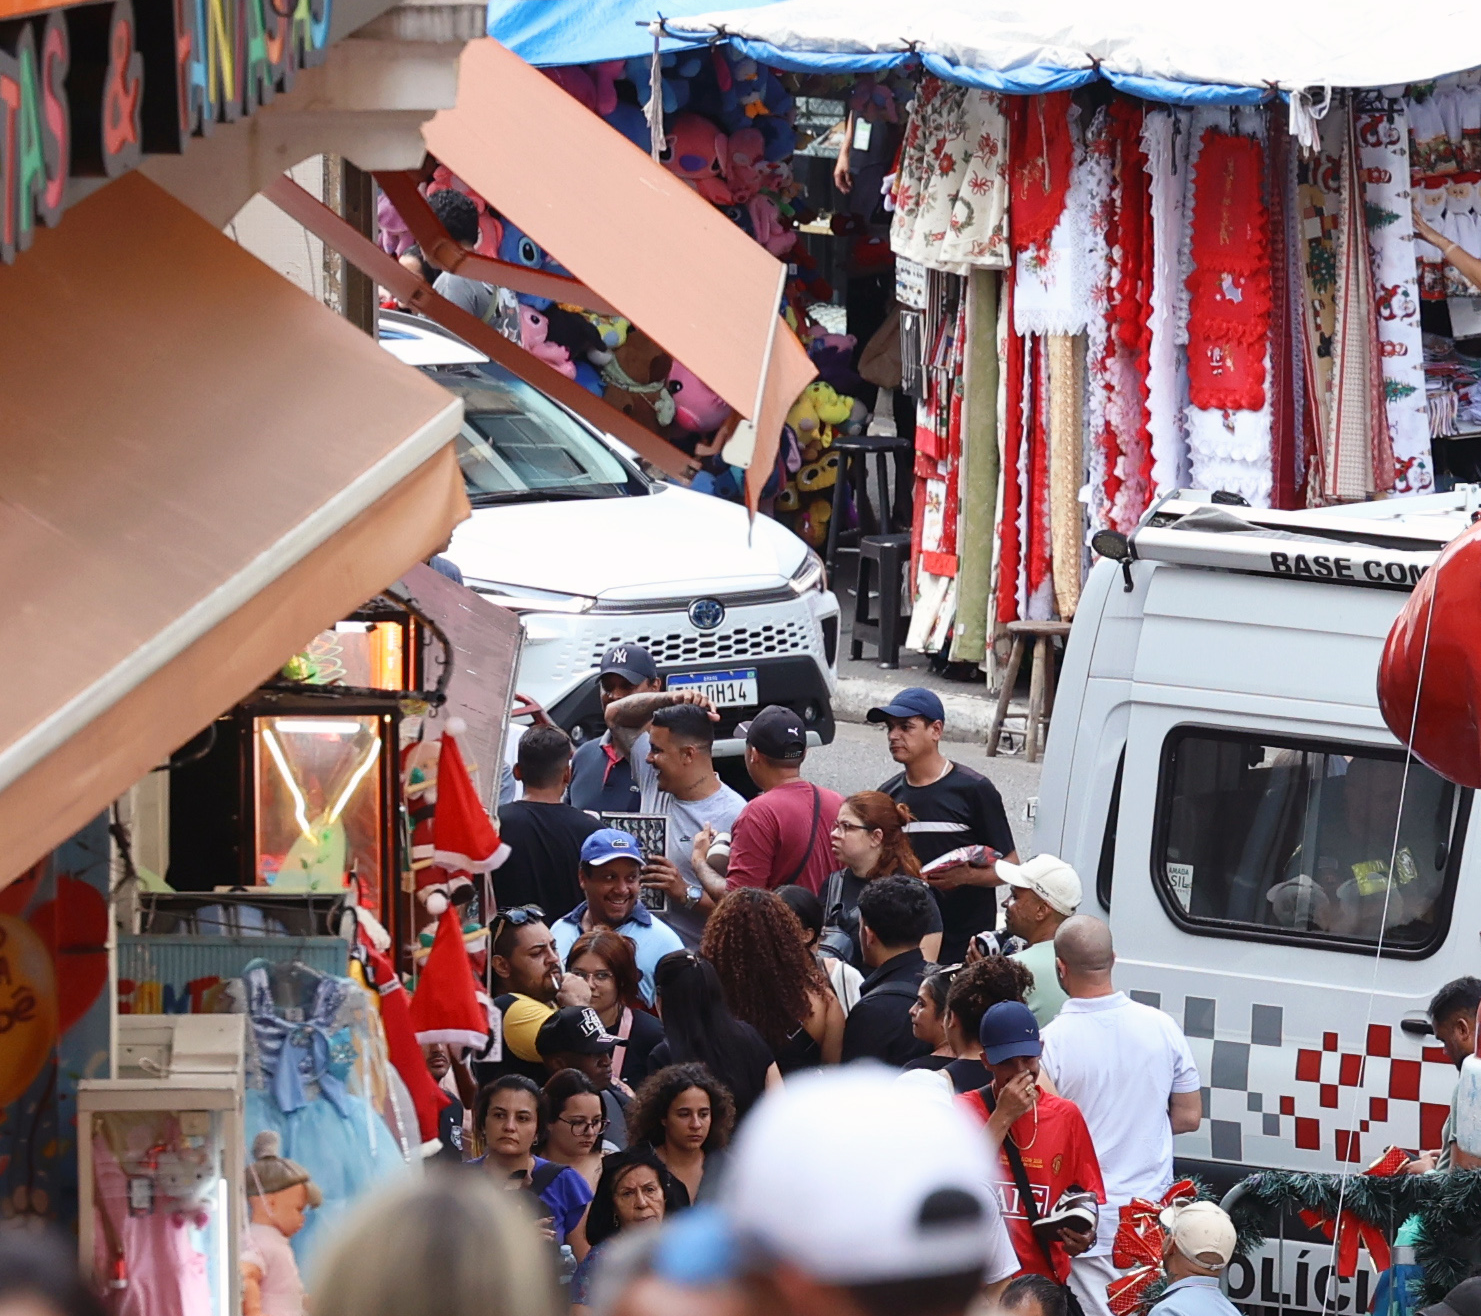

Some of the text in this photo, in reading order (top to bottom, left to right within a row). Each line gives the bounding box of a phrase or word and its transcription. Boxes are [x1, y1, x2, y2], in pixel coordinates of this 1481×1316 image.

[103, 2, 143, 170] &
[1270, 551, 1355, 581] BASE
[1226, 1249, 1370, 1315] OLÍCI
